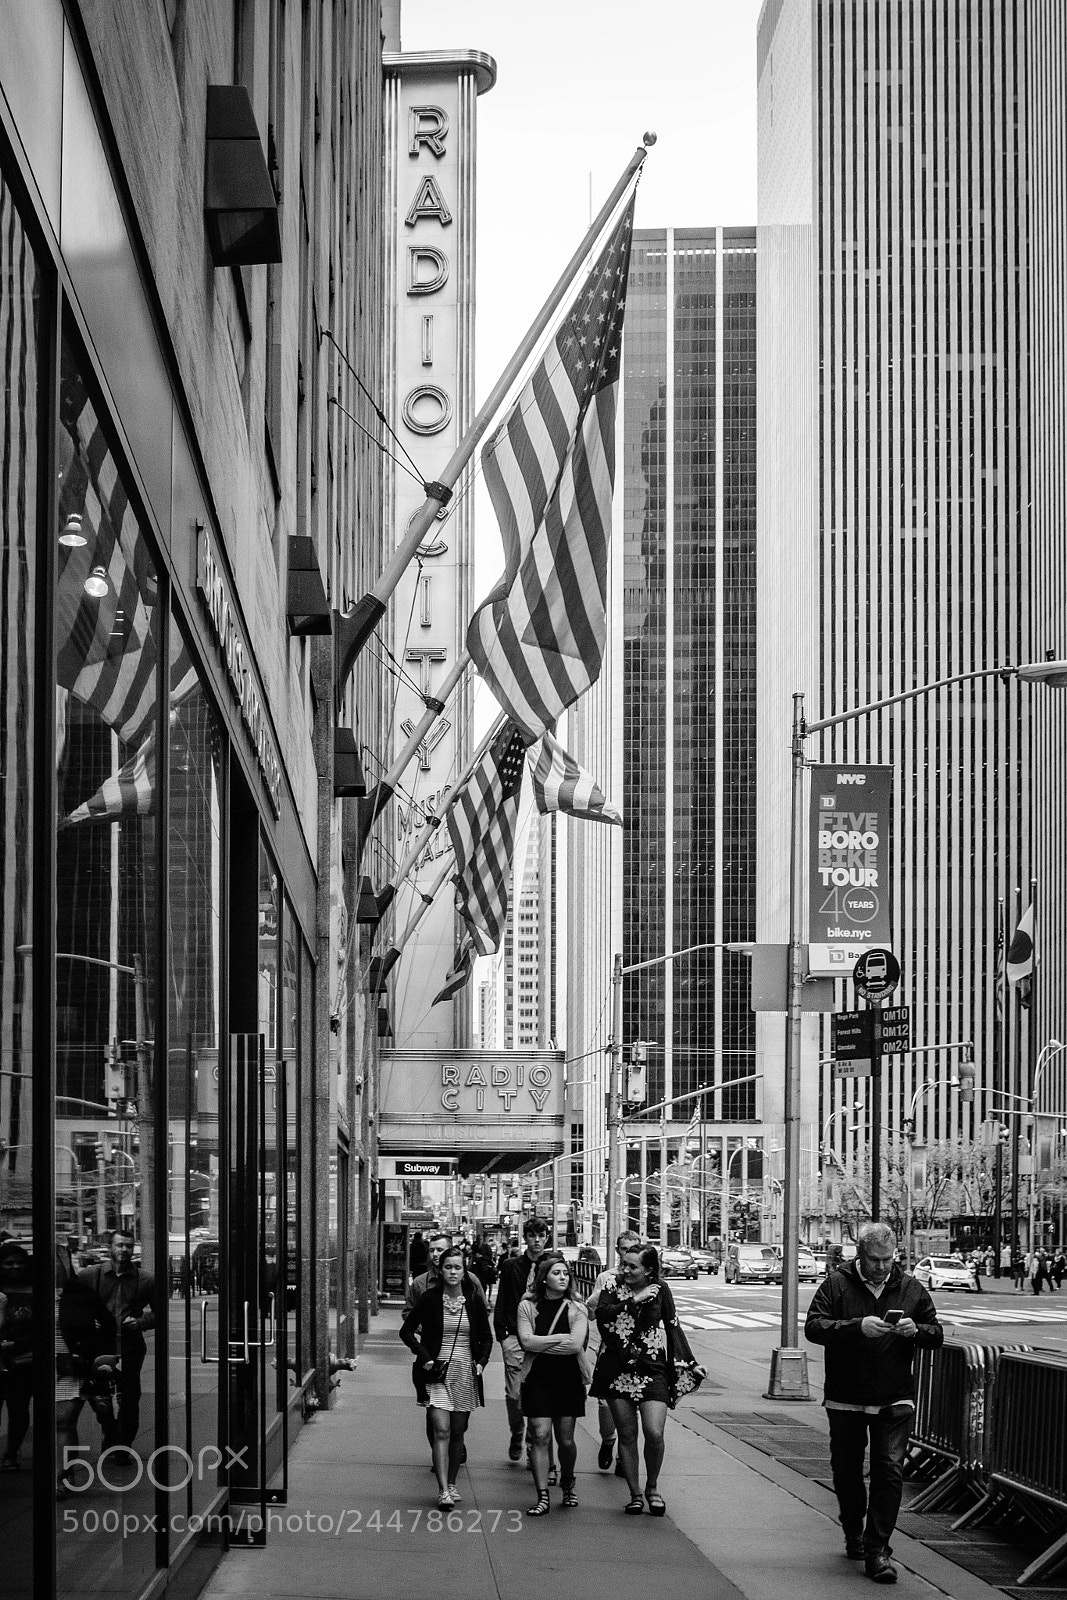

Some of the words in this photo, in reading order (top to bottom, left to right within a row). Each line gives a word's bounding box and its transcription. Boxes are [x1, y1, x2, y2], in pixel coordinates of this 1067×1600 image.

[402, 104, 453, 435] RADIO
[836, 773, 867, 785] NYC
[820, 796, 836, 808] TD
[818, 811, 878, 831] FIVE
[818, 830, 879, 850] BORO
[818, 849, 878, 868] BIKE
[818, 867, 879, 887] TOUR
[847, 900, 874, 909] YEARS
[827, 927, 872, 938] bike.nyc
[830, 951, 844, 961] TD
[857, 987, 867, 996] NO
[866, 984, 895, 999] STANDING
[883, 1008, 908, 1021] QM10
[883, 1024, 909, 1037] QM12
[883, 1040, 909, 1053] QM24
[442, 1064, 551, 1087] RADIO
[441, 1088, 551, 1111] CITY
[427, 1125, 487, 1139] MUSIC
[502, 1125, 551, 1139] HALL
[404, 1163, 441, 1174] Subway
